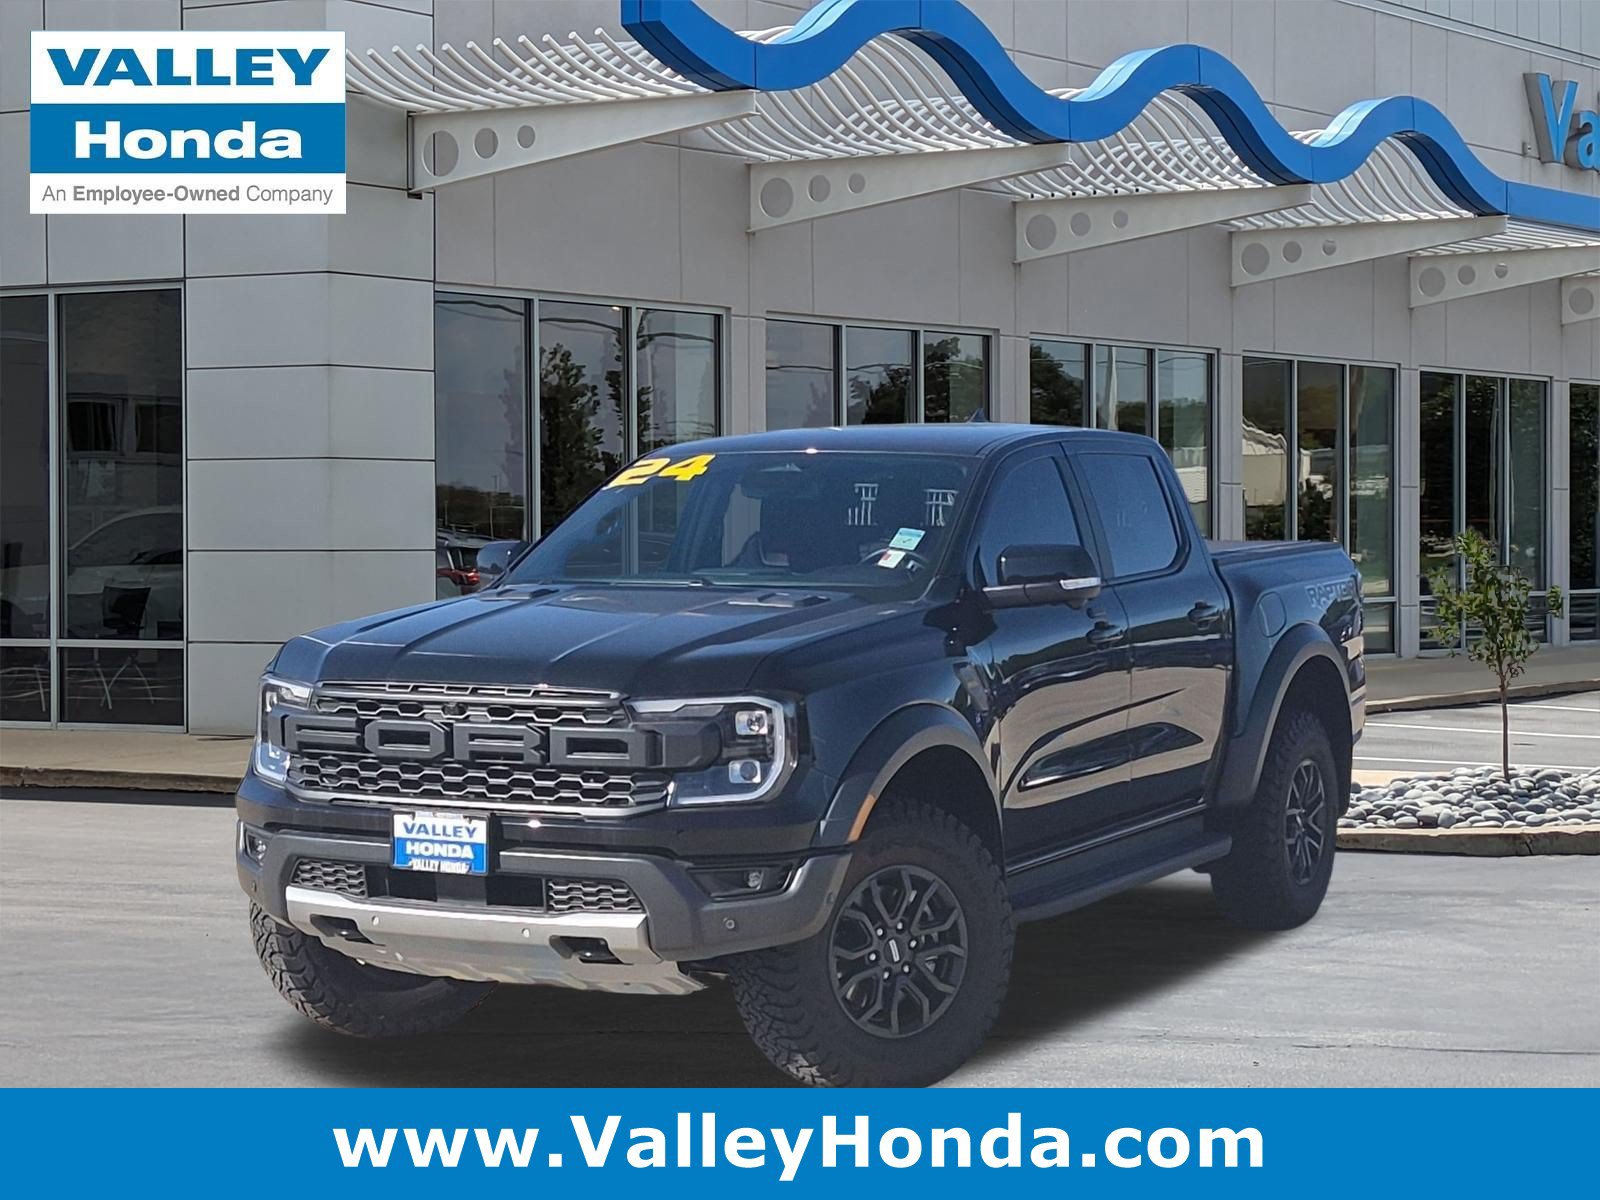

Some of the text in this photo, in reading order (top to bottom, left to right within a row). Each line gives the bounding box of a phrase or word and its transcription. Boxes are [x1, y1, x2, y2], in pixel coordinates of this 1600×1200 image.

[602, 454, 716, 490] 24
[283, 710, 655, 768] FORD
[402, 822, 477, 839] VALLEY
[405, 841, 475, 860] HONDA
